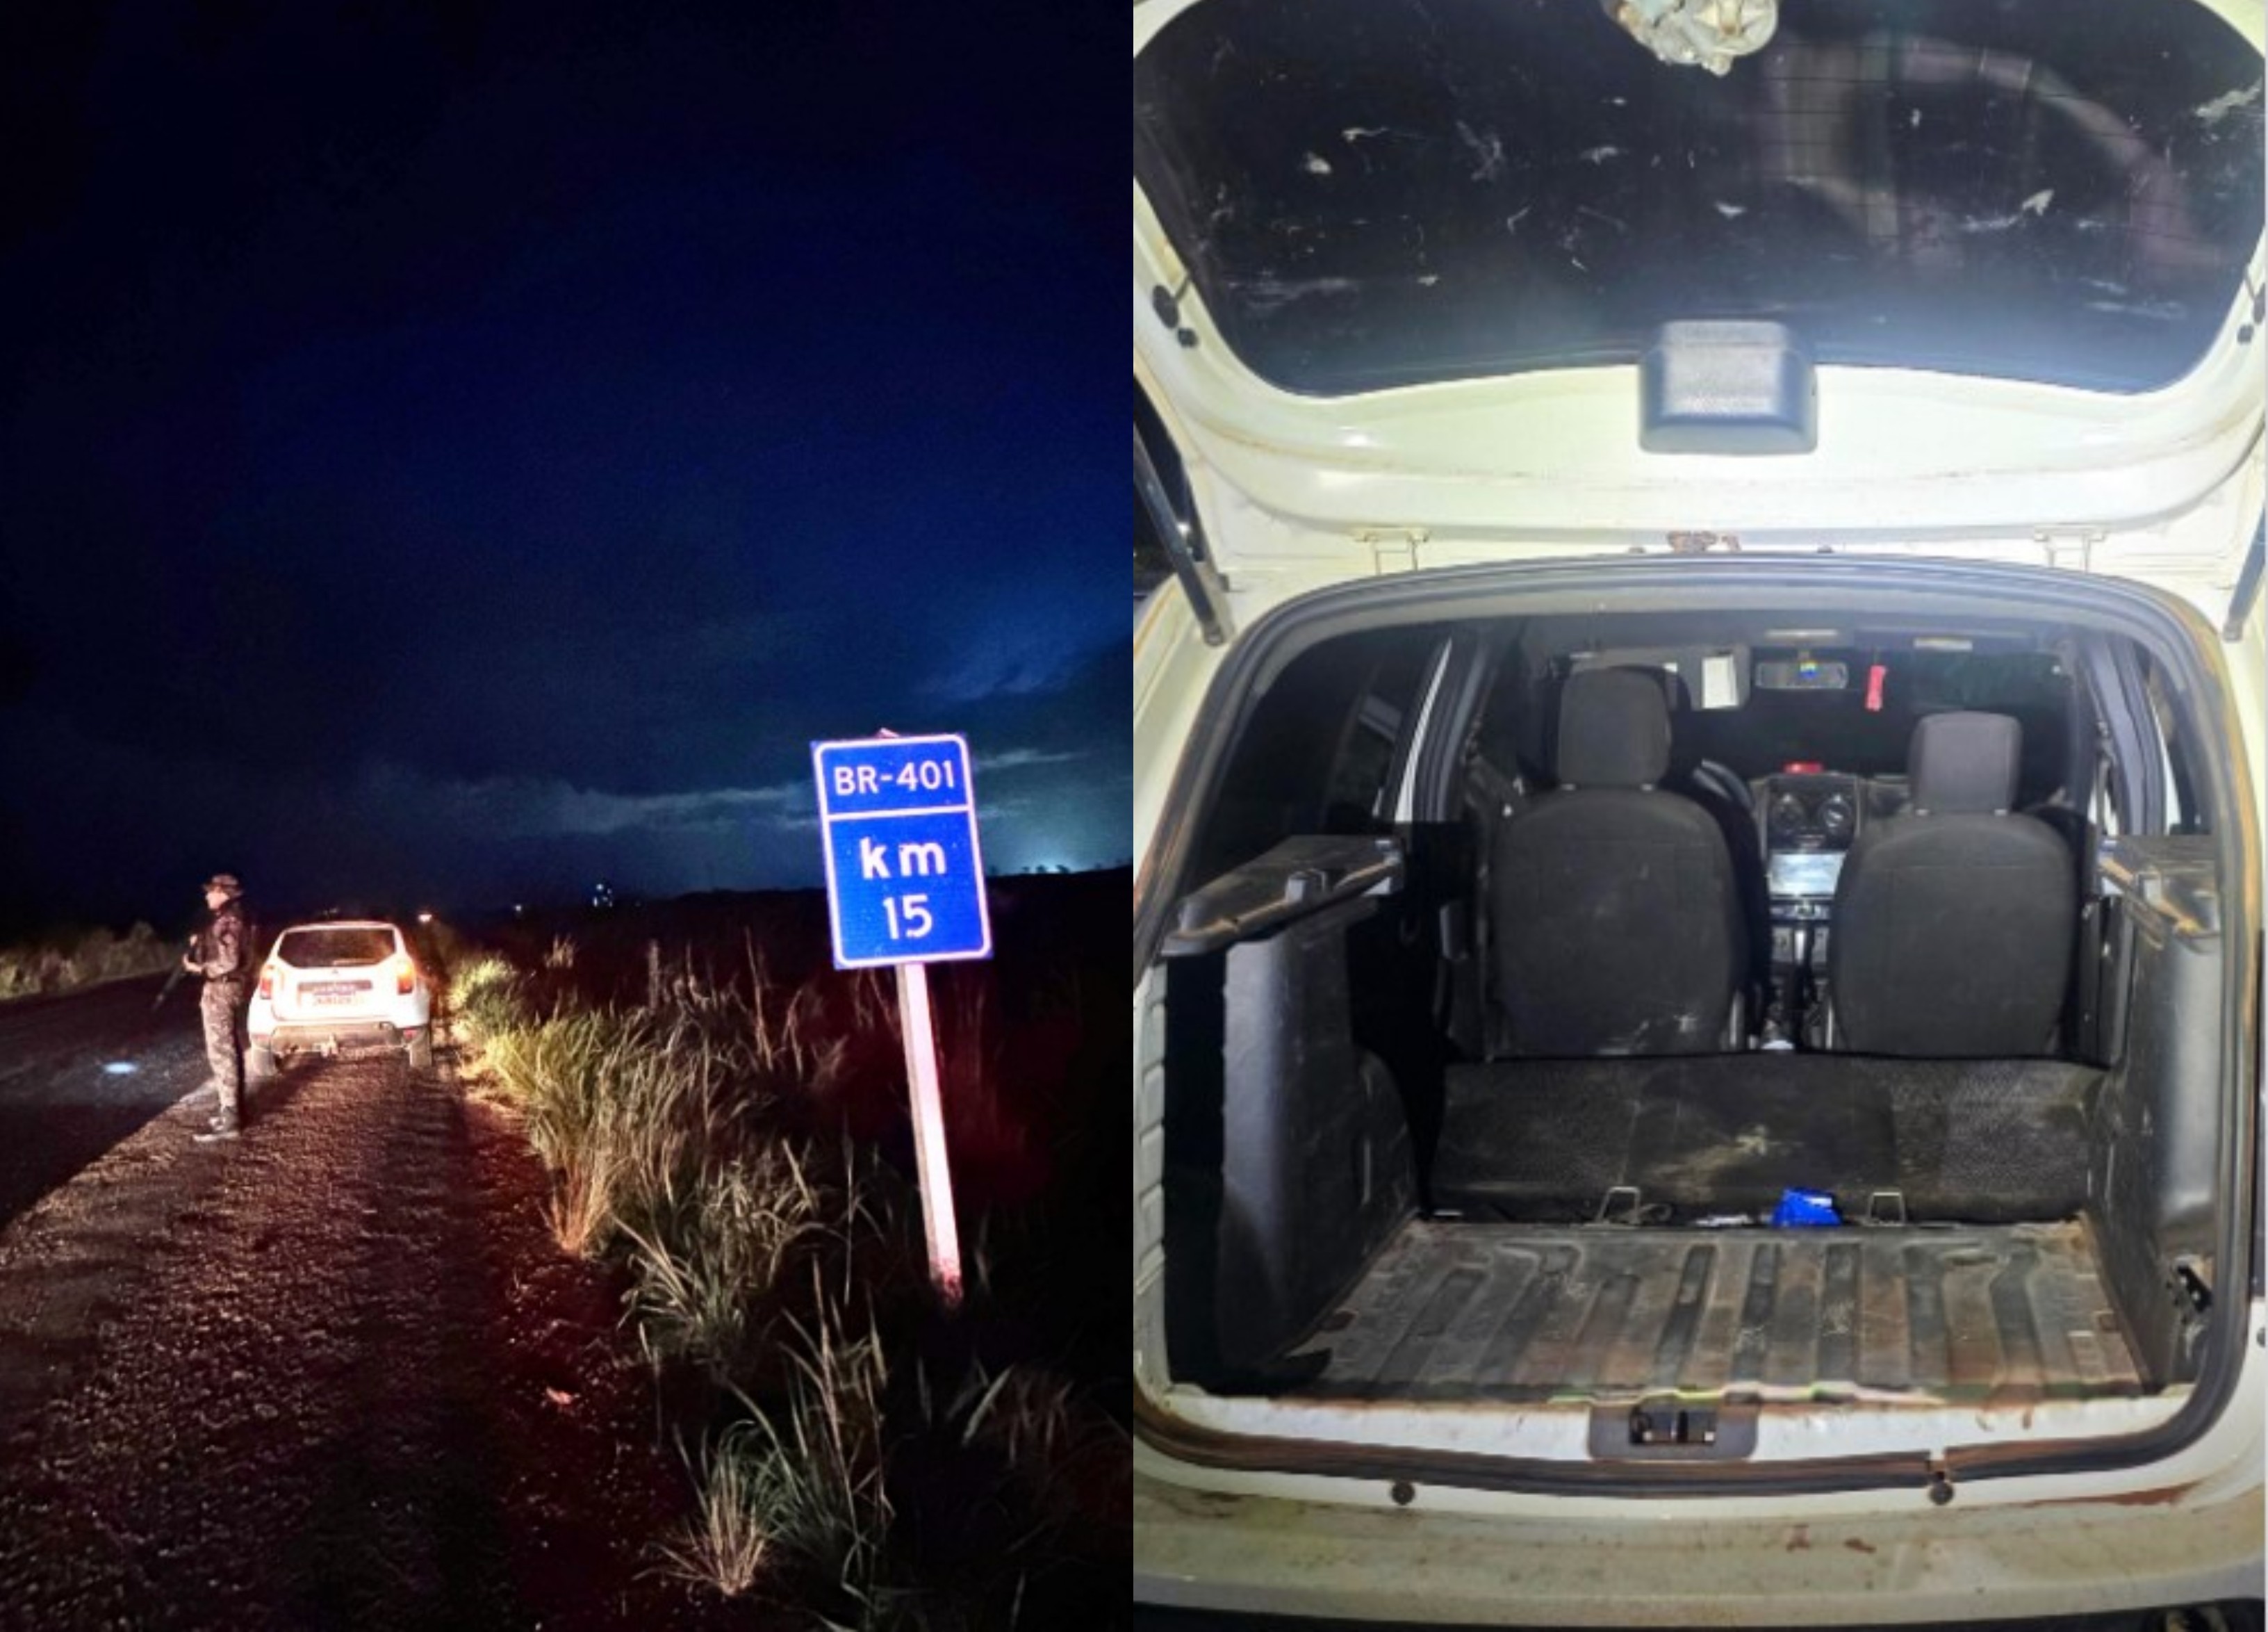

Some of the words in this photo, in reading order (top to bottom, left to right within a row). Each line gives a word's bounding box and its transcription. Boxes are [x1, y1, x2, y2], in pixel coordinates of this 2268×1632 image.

[834, 760, 954, 795] BR-401
[860, 837, 946, 879] km
[883, 893, 932, 940] 15
